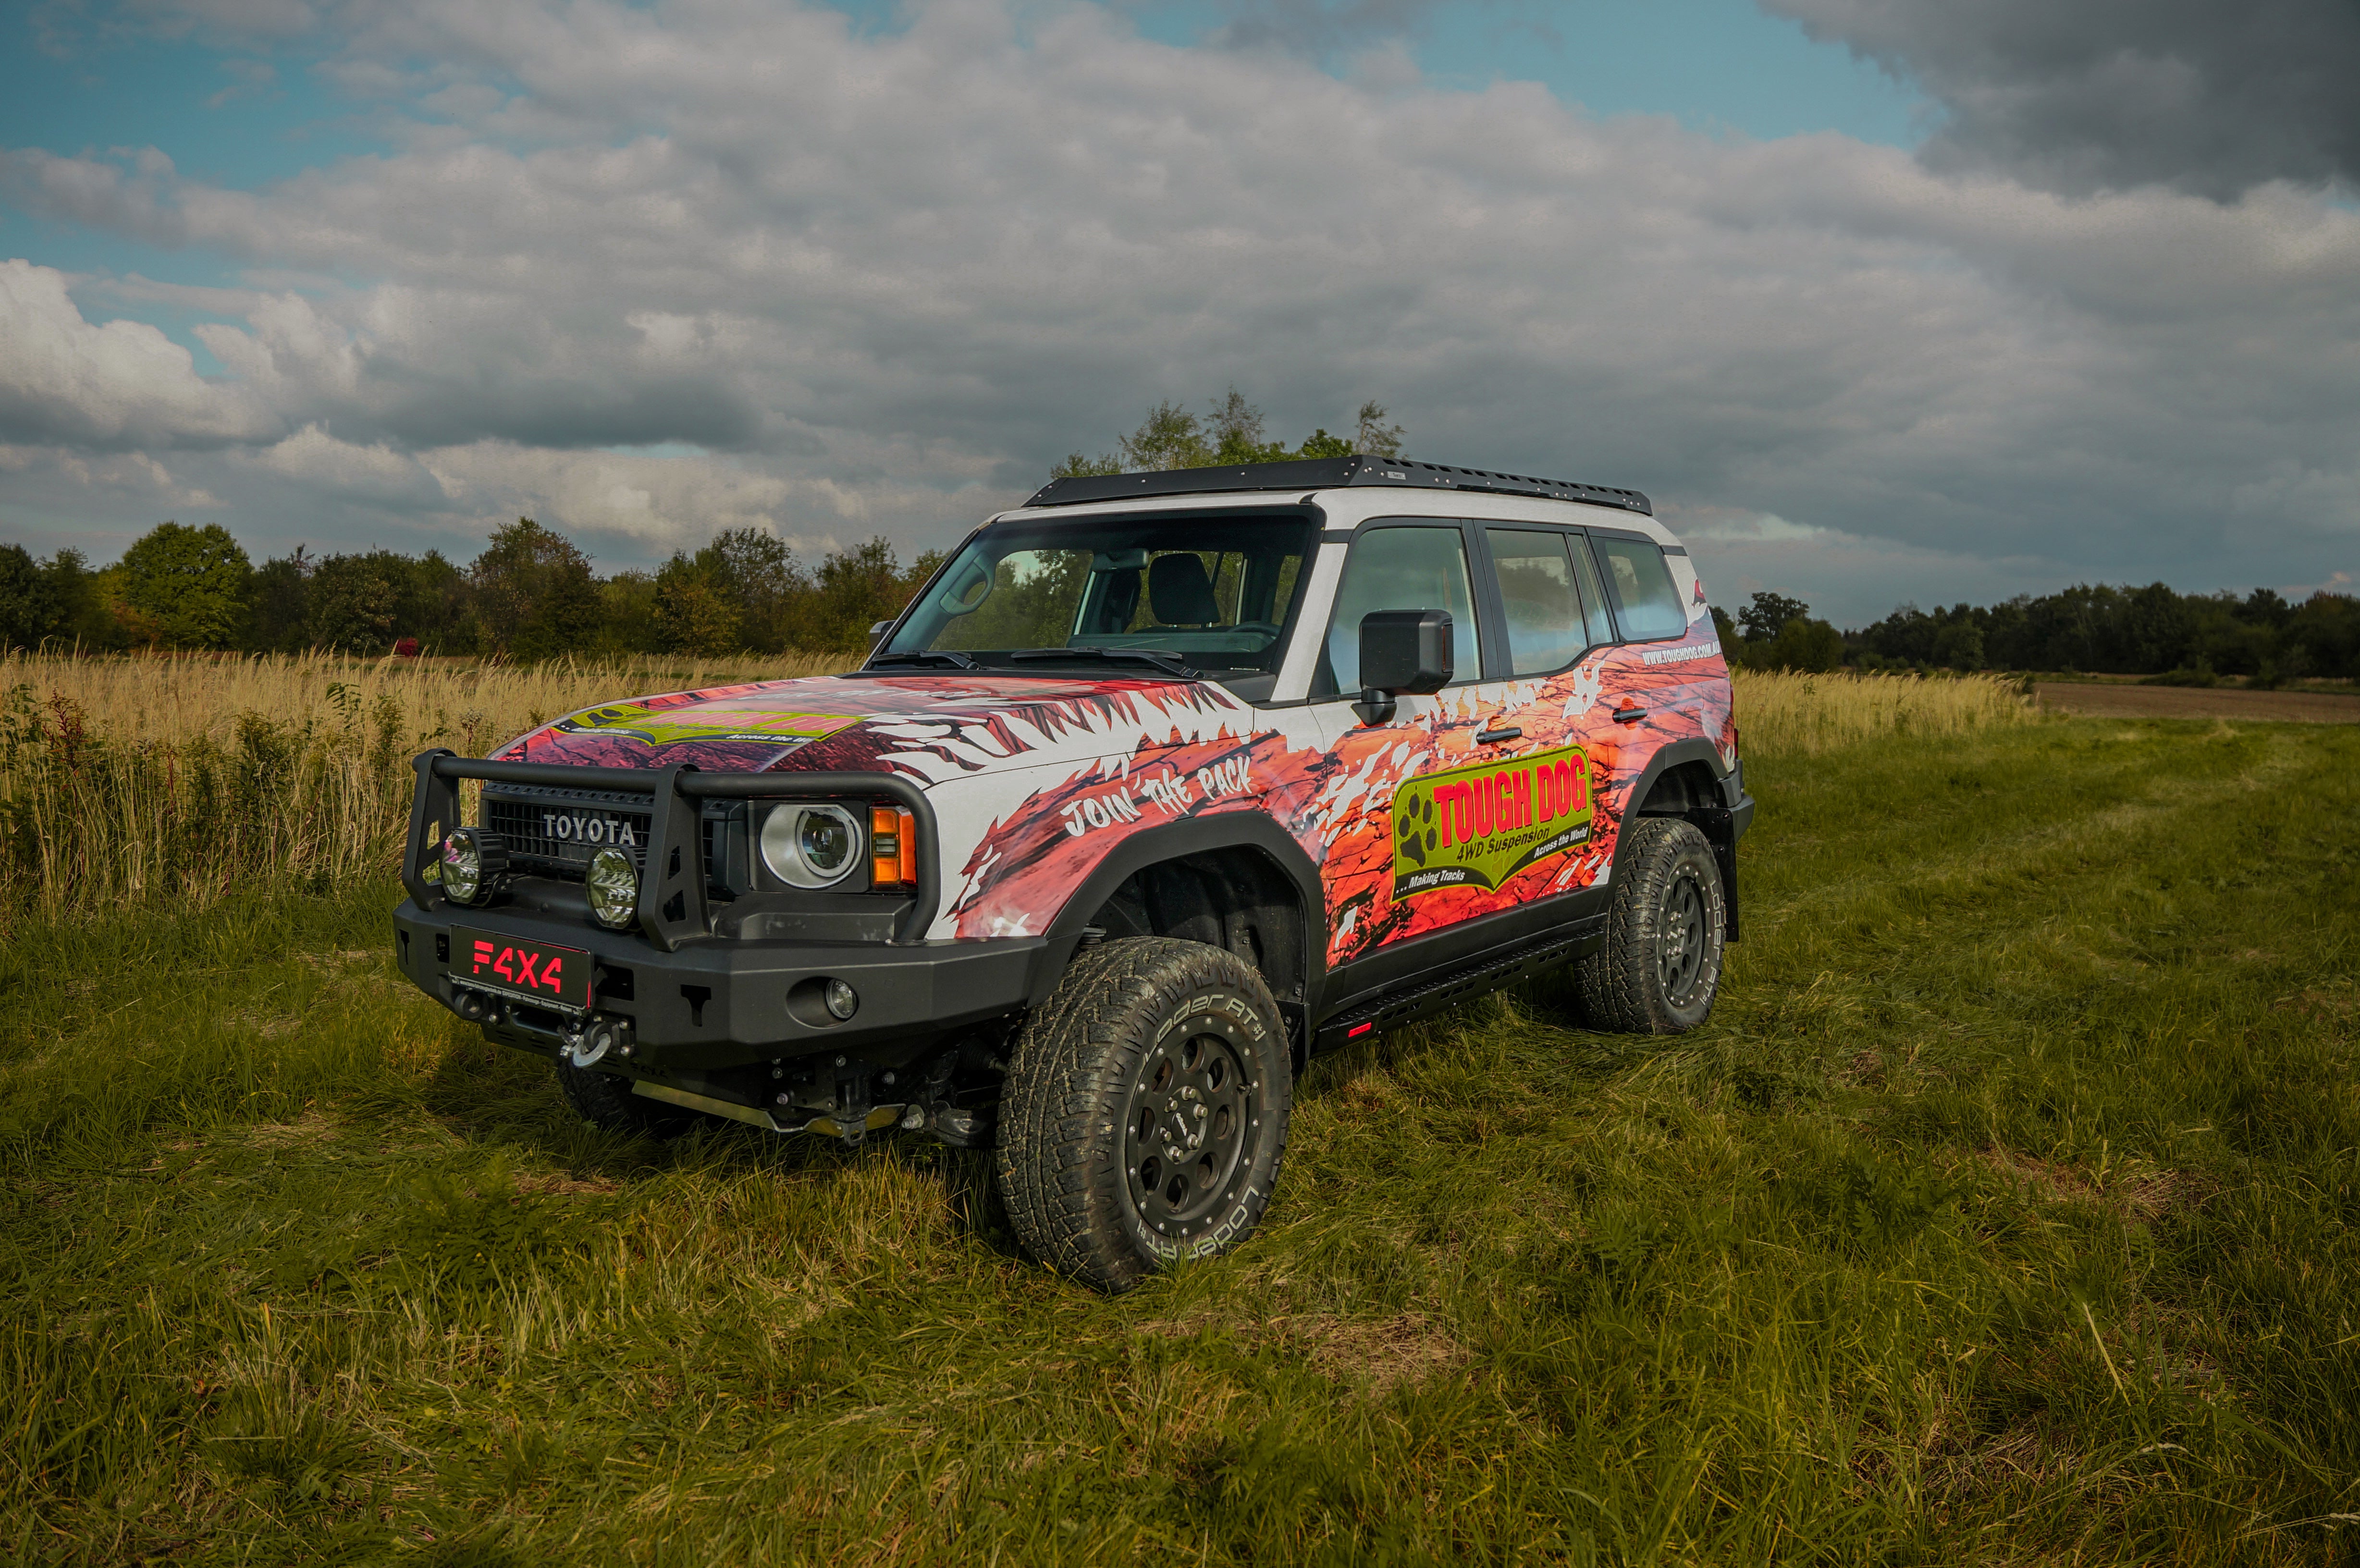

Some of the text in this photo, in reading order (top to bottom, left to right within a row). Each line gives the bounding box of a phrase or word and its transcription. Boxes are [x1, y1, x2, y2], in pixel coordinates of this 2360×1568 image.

[1642, 640, 1720, 666] WWW.TOUGHDOG.COM.AU
[1197, 756, 1254, 800] PACK
[1433, 754, 1587, 848] TOUGH DOG
[543, 814, 636, 845] TOYOTA
[1457, 826, 1550, 862] 4WD Suspension
[1533, 827, 1588, 858] Across the World
[1440, 869, 1465, 882] Tracks
[473, 940, 562, 993] F4X4
